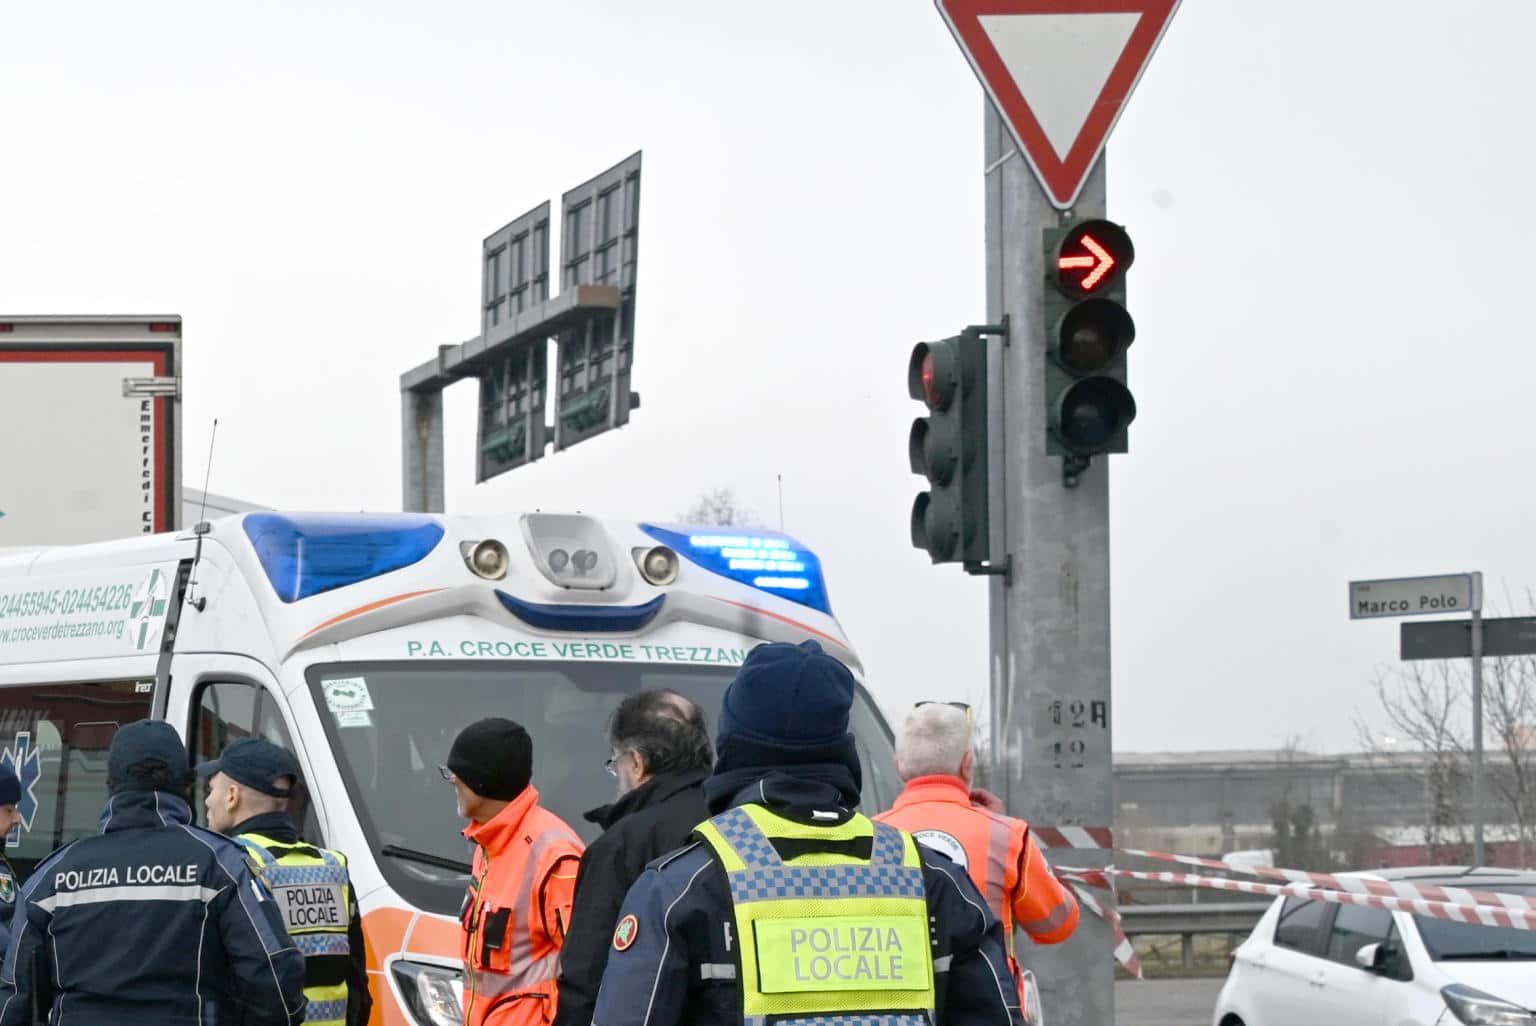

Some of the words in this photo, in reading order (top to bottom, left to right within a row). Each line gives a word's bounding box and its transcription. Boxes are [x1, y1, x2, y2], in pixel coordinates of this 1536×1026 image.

[142, 511, 151, 533] Ca
[1358, 599, 1408, 614] Marco
[1419, 595, 1457, 609] Polo
[408, 640, 453, 656] P.A.
[460, 641, 547, 657] CROCE
[552, 643, 635, 659] VERDE
[55, 867, 119, 890] POLIZIA
[126, 865, 198, 884] LOCALE
[287, 888, 335, 906] POLIZIA
[289, 907, 339, 926] LOCALE
[791, 927, 903, 952] POLIZIA
[794, 954, 904, 981] LOCALE
